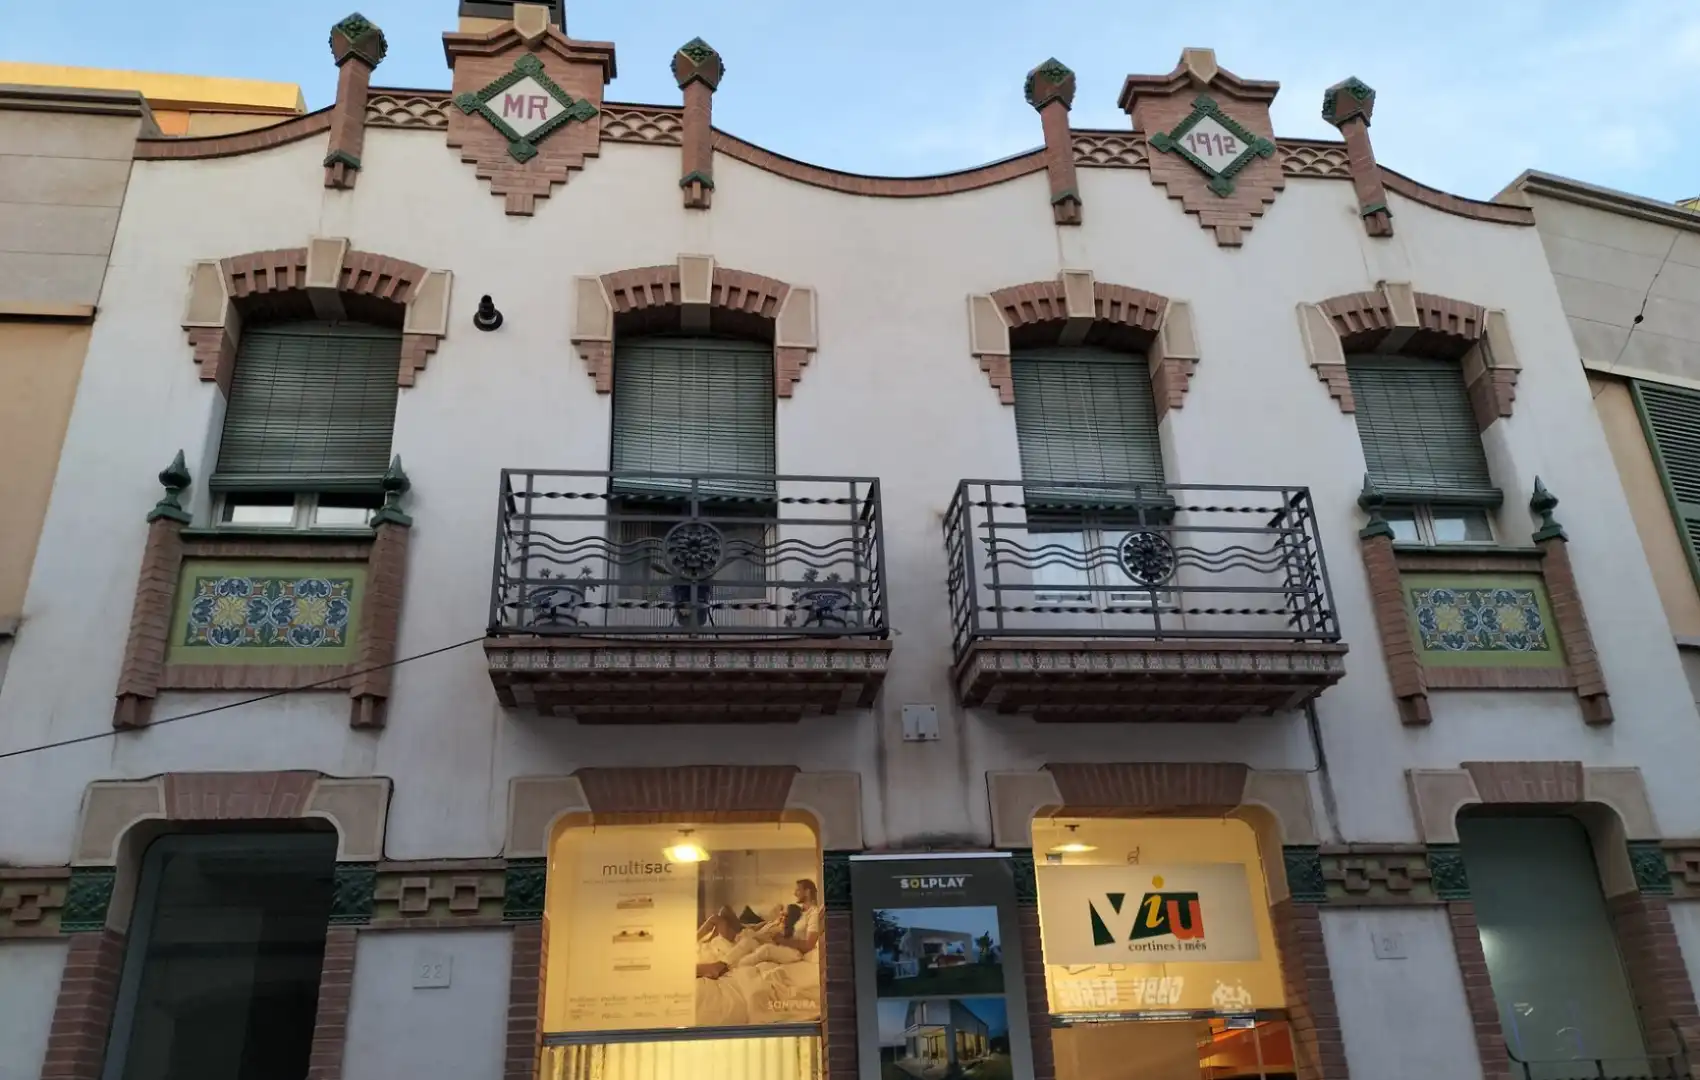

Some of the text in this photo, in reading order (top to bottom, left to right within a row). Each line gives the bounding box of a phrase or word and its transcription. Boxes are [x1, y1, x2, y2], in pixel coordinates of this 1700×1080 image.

[502, 93, 549, 121] MR
[1185, 132, 1238, 157] 1912
[602, 860, 673, 876] multisac
[900, 877, 966, 889] SOLPLAY
[1127, 940, 1176, 952] cortines
[1184, 939, 1208, 952] més
[420, 963, 444, 979] 22
